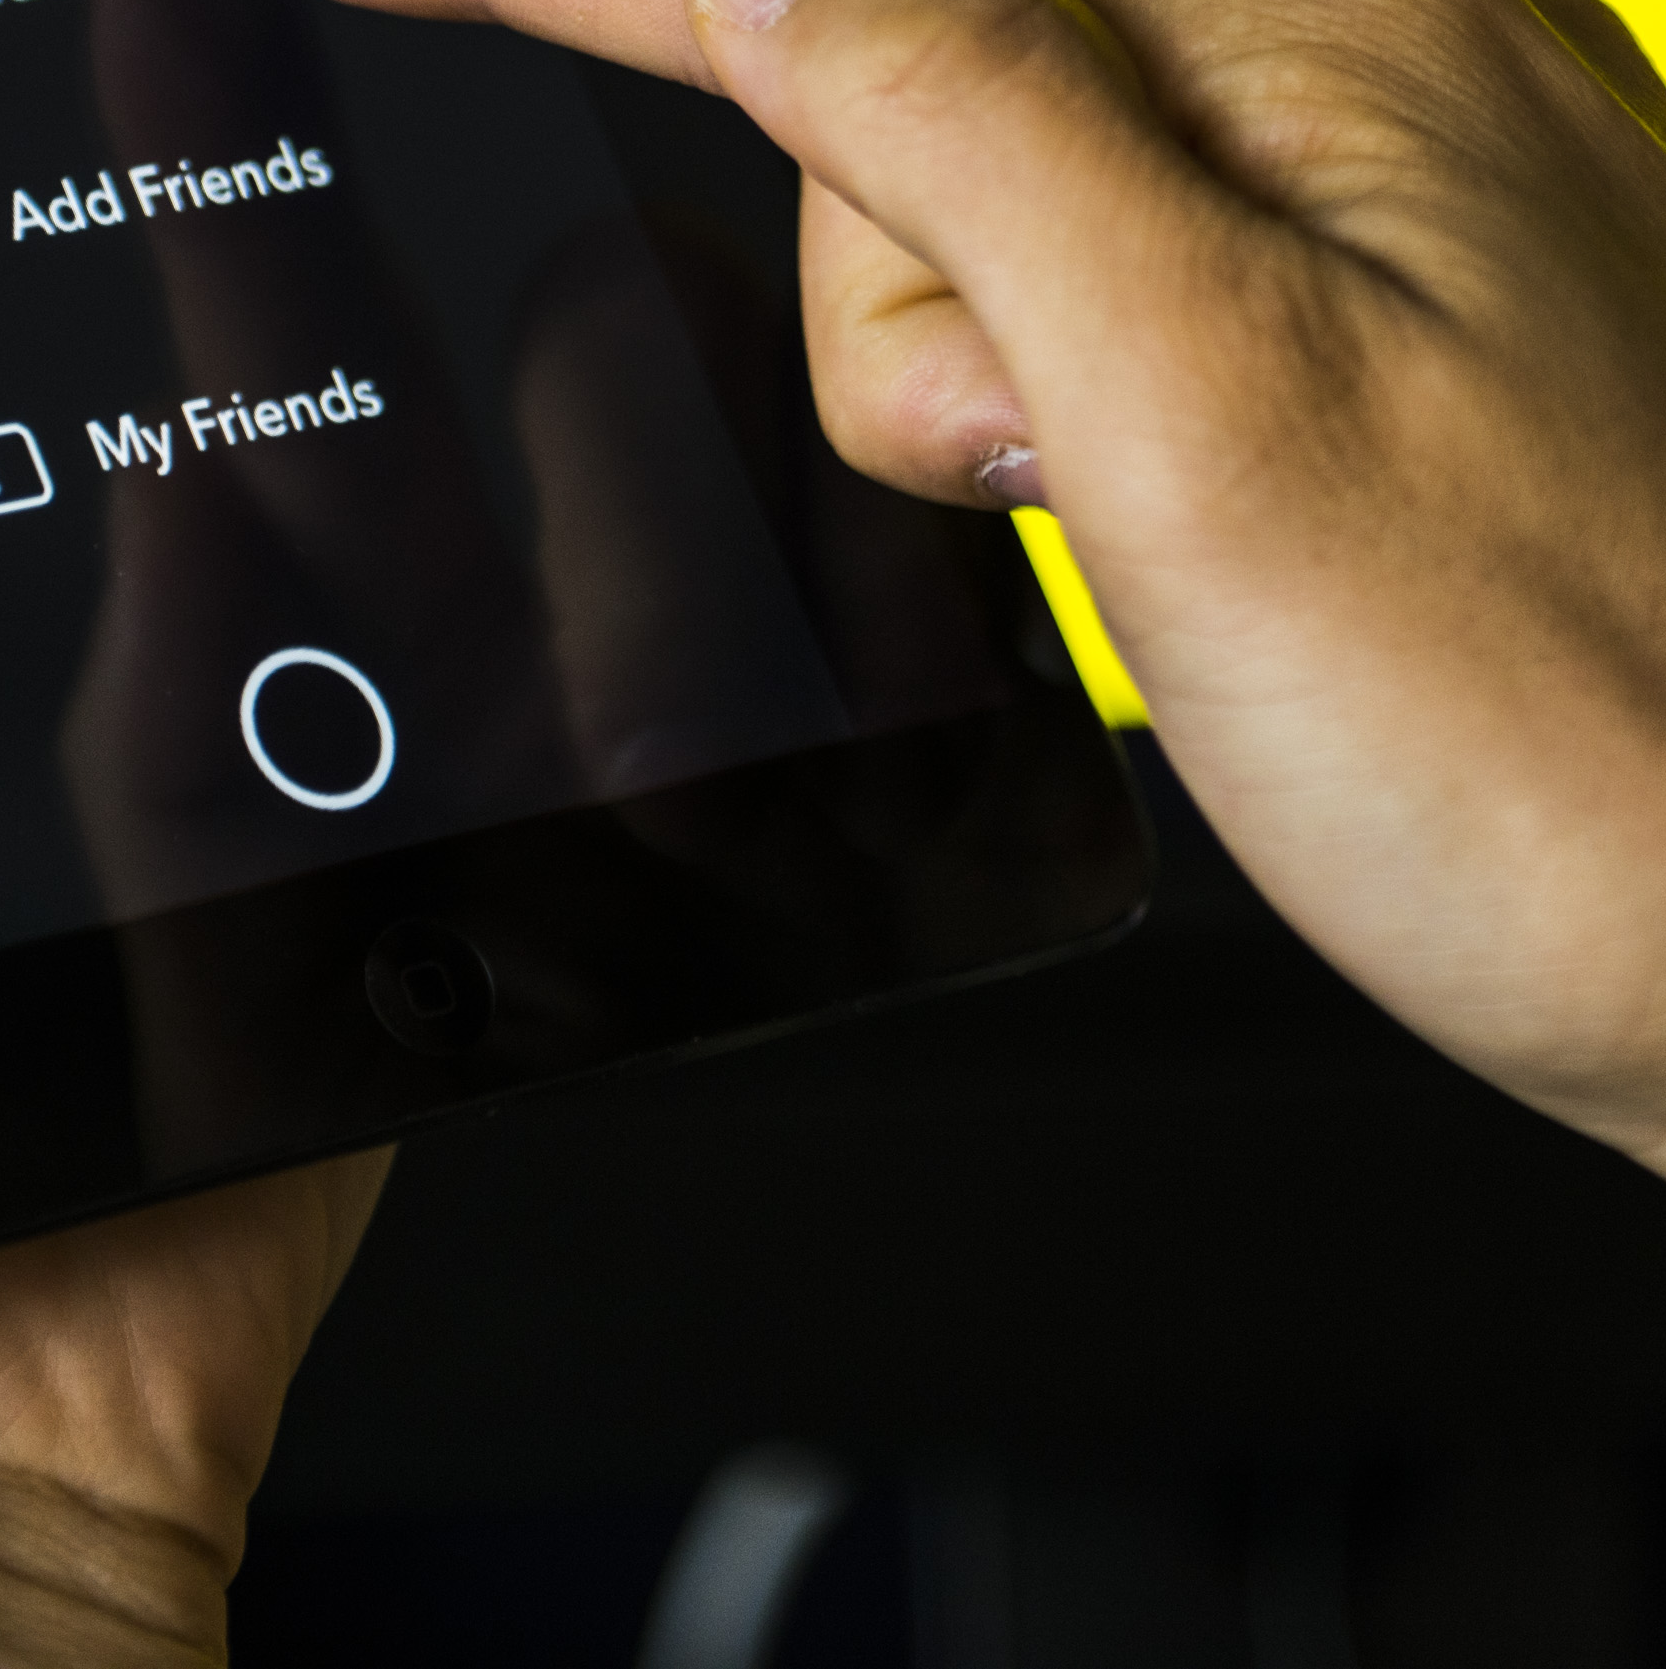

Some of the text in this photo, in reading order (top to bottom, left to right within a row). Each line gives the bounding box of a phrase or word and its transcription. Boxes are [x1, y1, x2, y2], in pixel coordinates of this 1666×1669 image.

[12, 136, 333, 241] Add Friends
[86, 368, 385, 477] My Friends
